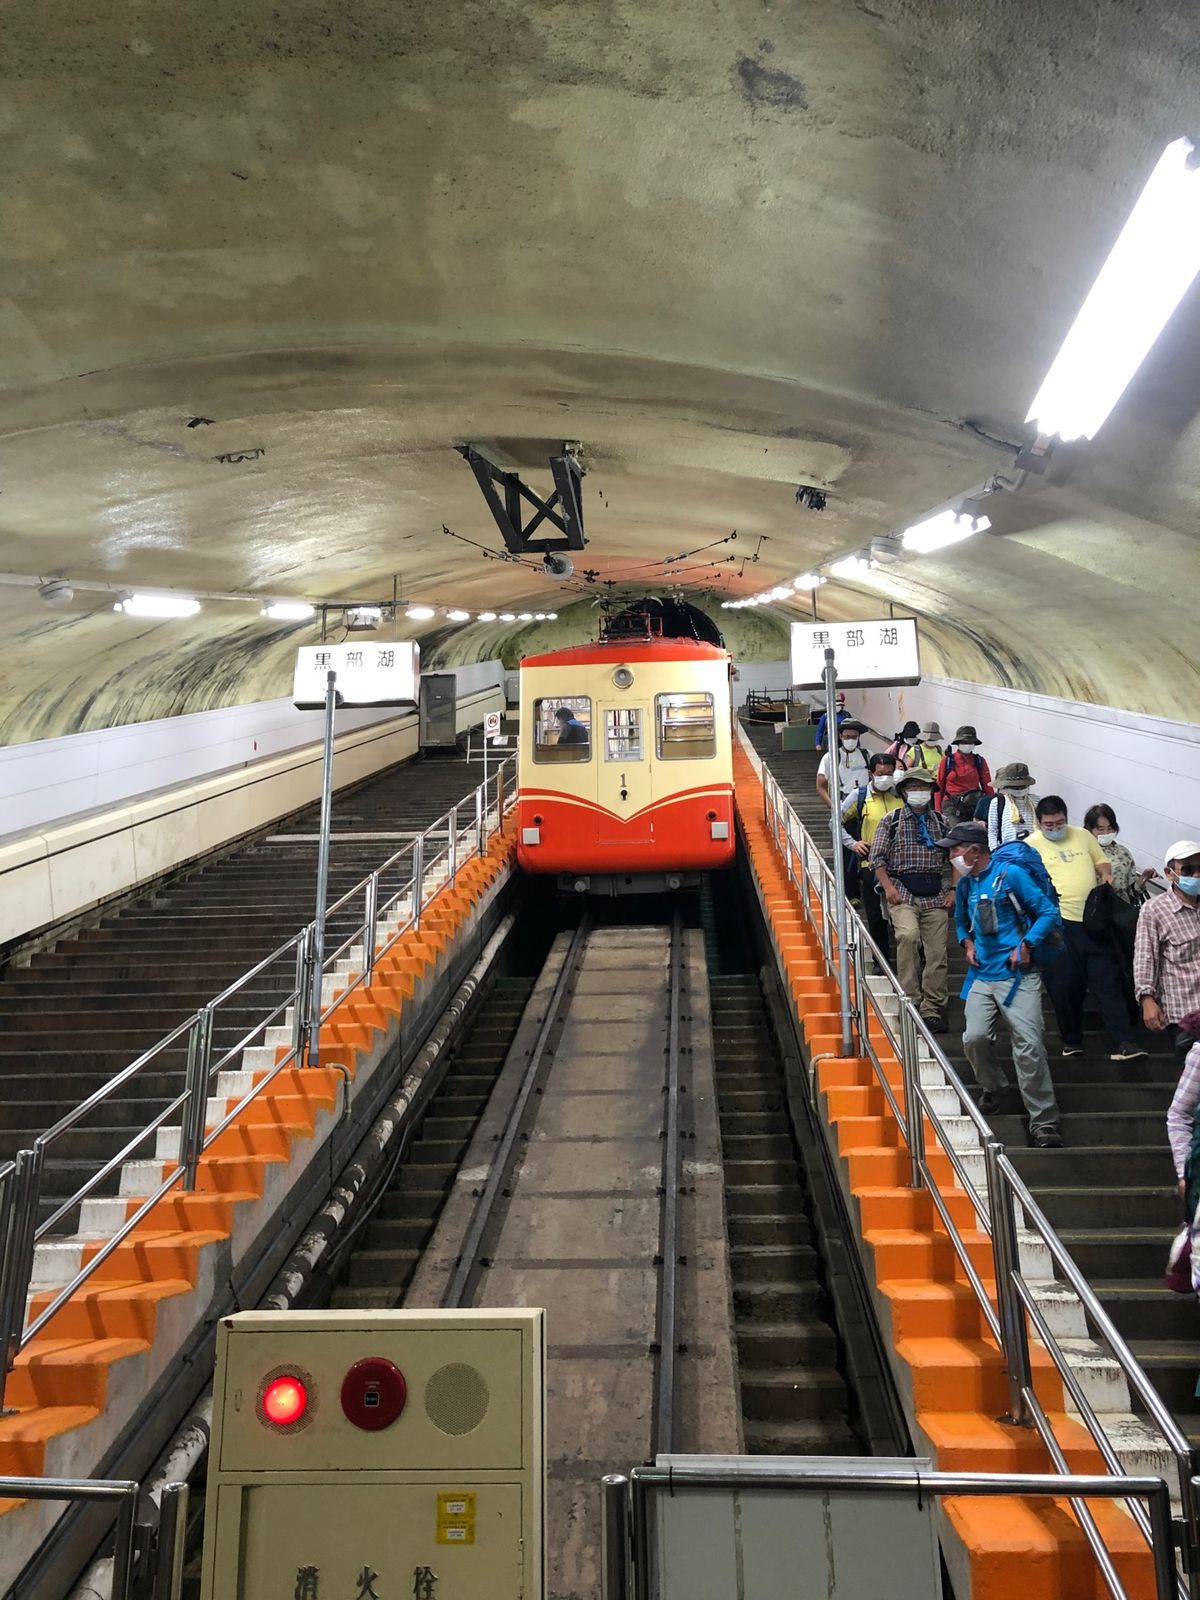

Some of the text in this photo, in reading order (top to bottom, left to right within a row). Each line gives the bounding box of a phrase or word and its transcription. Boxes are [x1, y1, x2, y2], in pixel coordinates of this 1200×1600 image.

[813, 628, 898, 649] 黒部湖
[314, 650, 395, 670] 黒部湖
[620, 773, 627, 788] 1
[295, 1565, 438, 1600] 消火栓
